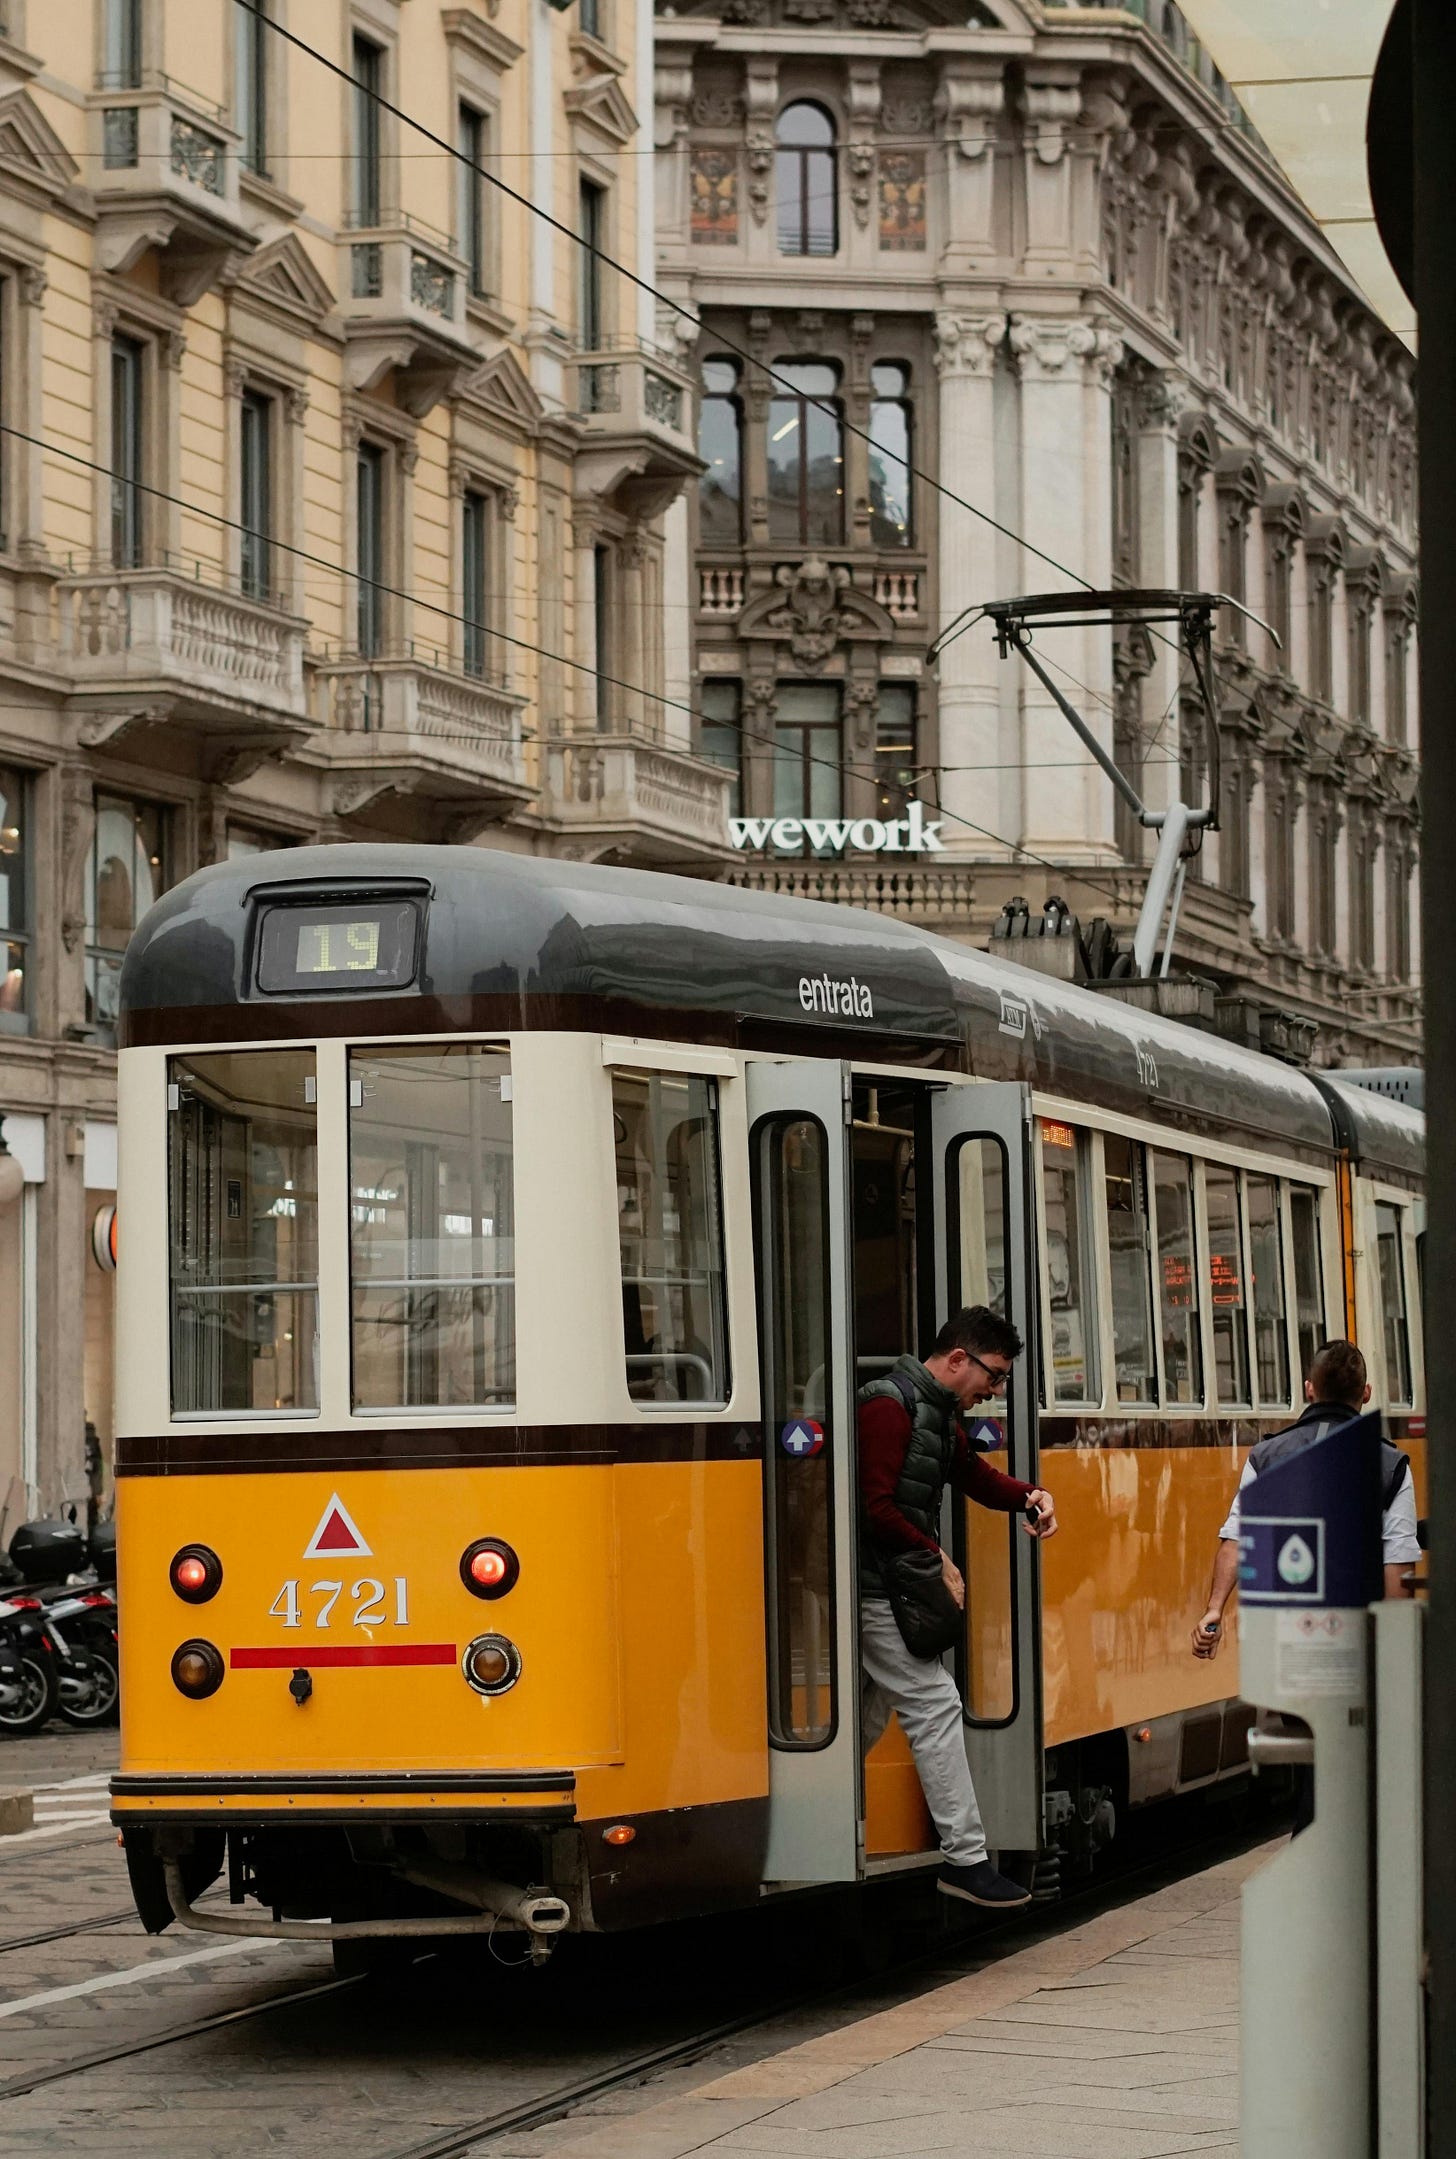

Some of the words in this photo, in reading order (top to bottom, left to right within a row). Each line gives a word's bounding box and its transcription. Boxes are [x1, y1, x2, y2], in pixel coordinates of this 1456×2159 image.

[728, 800, 948, 852] wework
[313, 922, 380, 972] 19
[798, 972, 874, 1018] entrata
[1135, 1047, 1159, 1088] 4721
[268, 1577, 409, 1628] 4721
